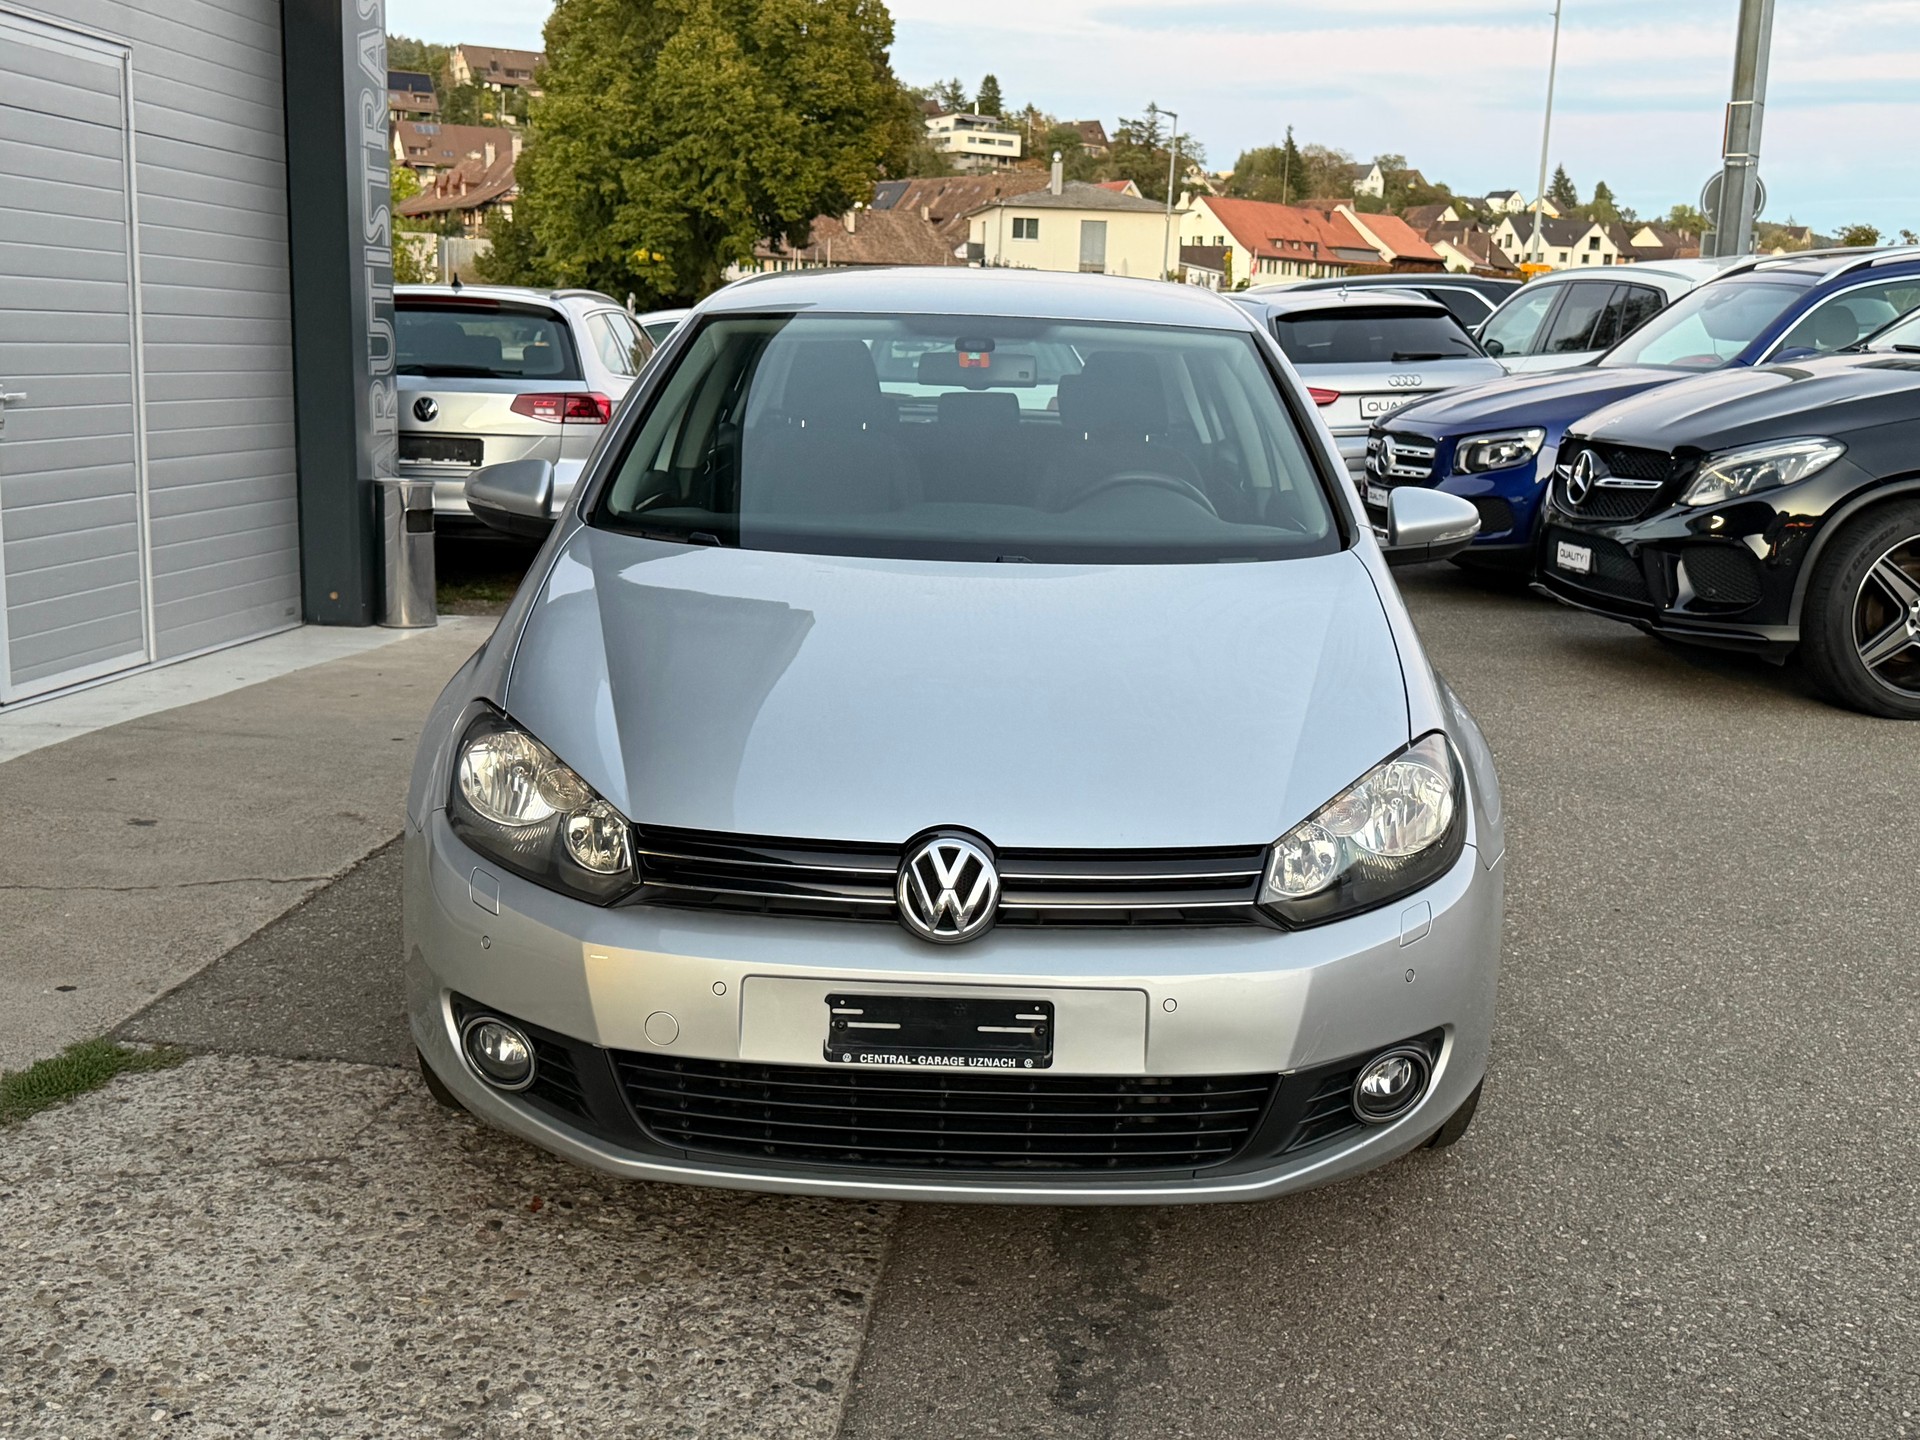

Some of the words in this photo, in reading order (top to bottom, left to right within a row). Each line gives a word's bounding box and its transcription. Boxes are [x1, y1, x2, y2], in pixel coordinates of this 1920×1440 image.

[1367, 401, 1403, 411] QUA
[898, 838, 998, 941] VW
[968, 1057, 1016, 1068] UZNACH
